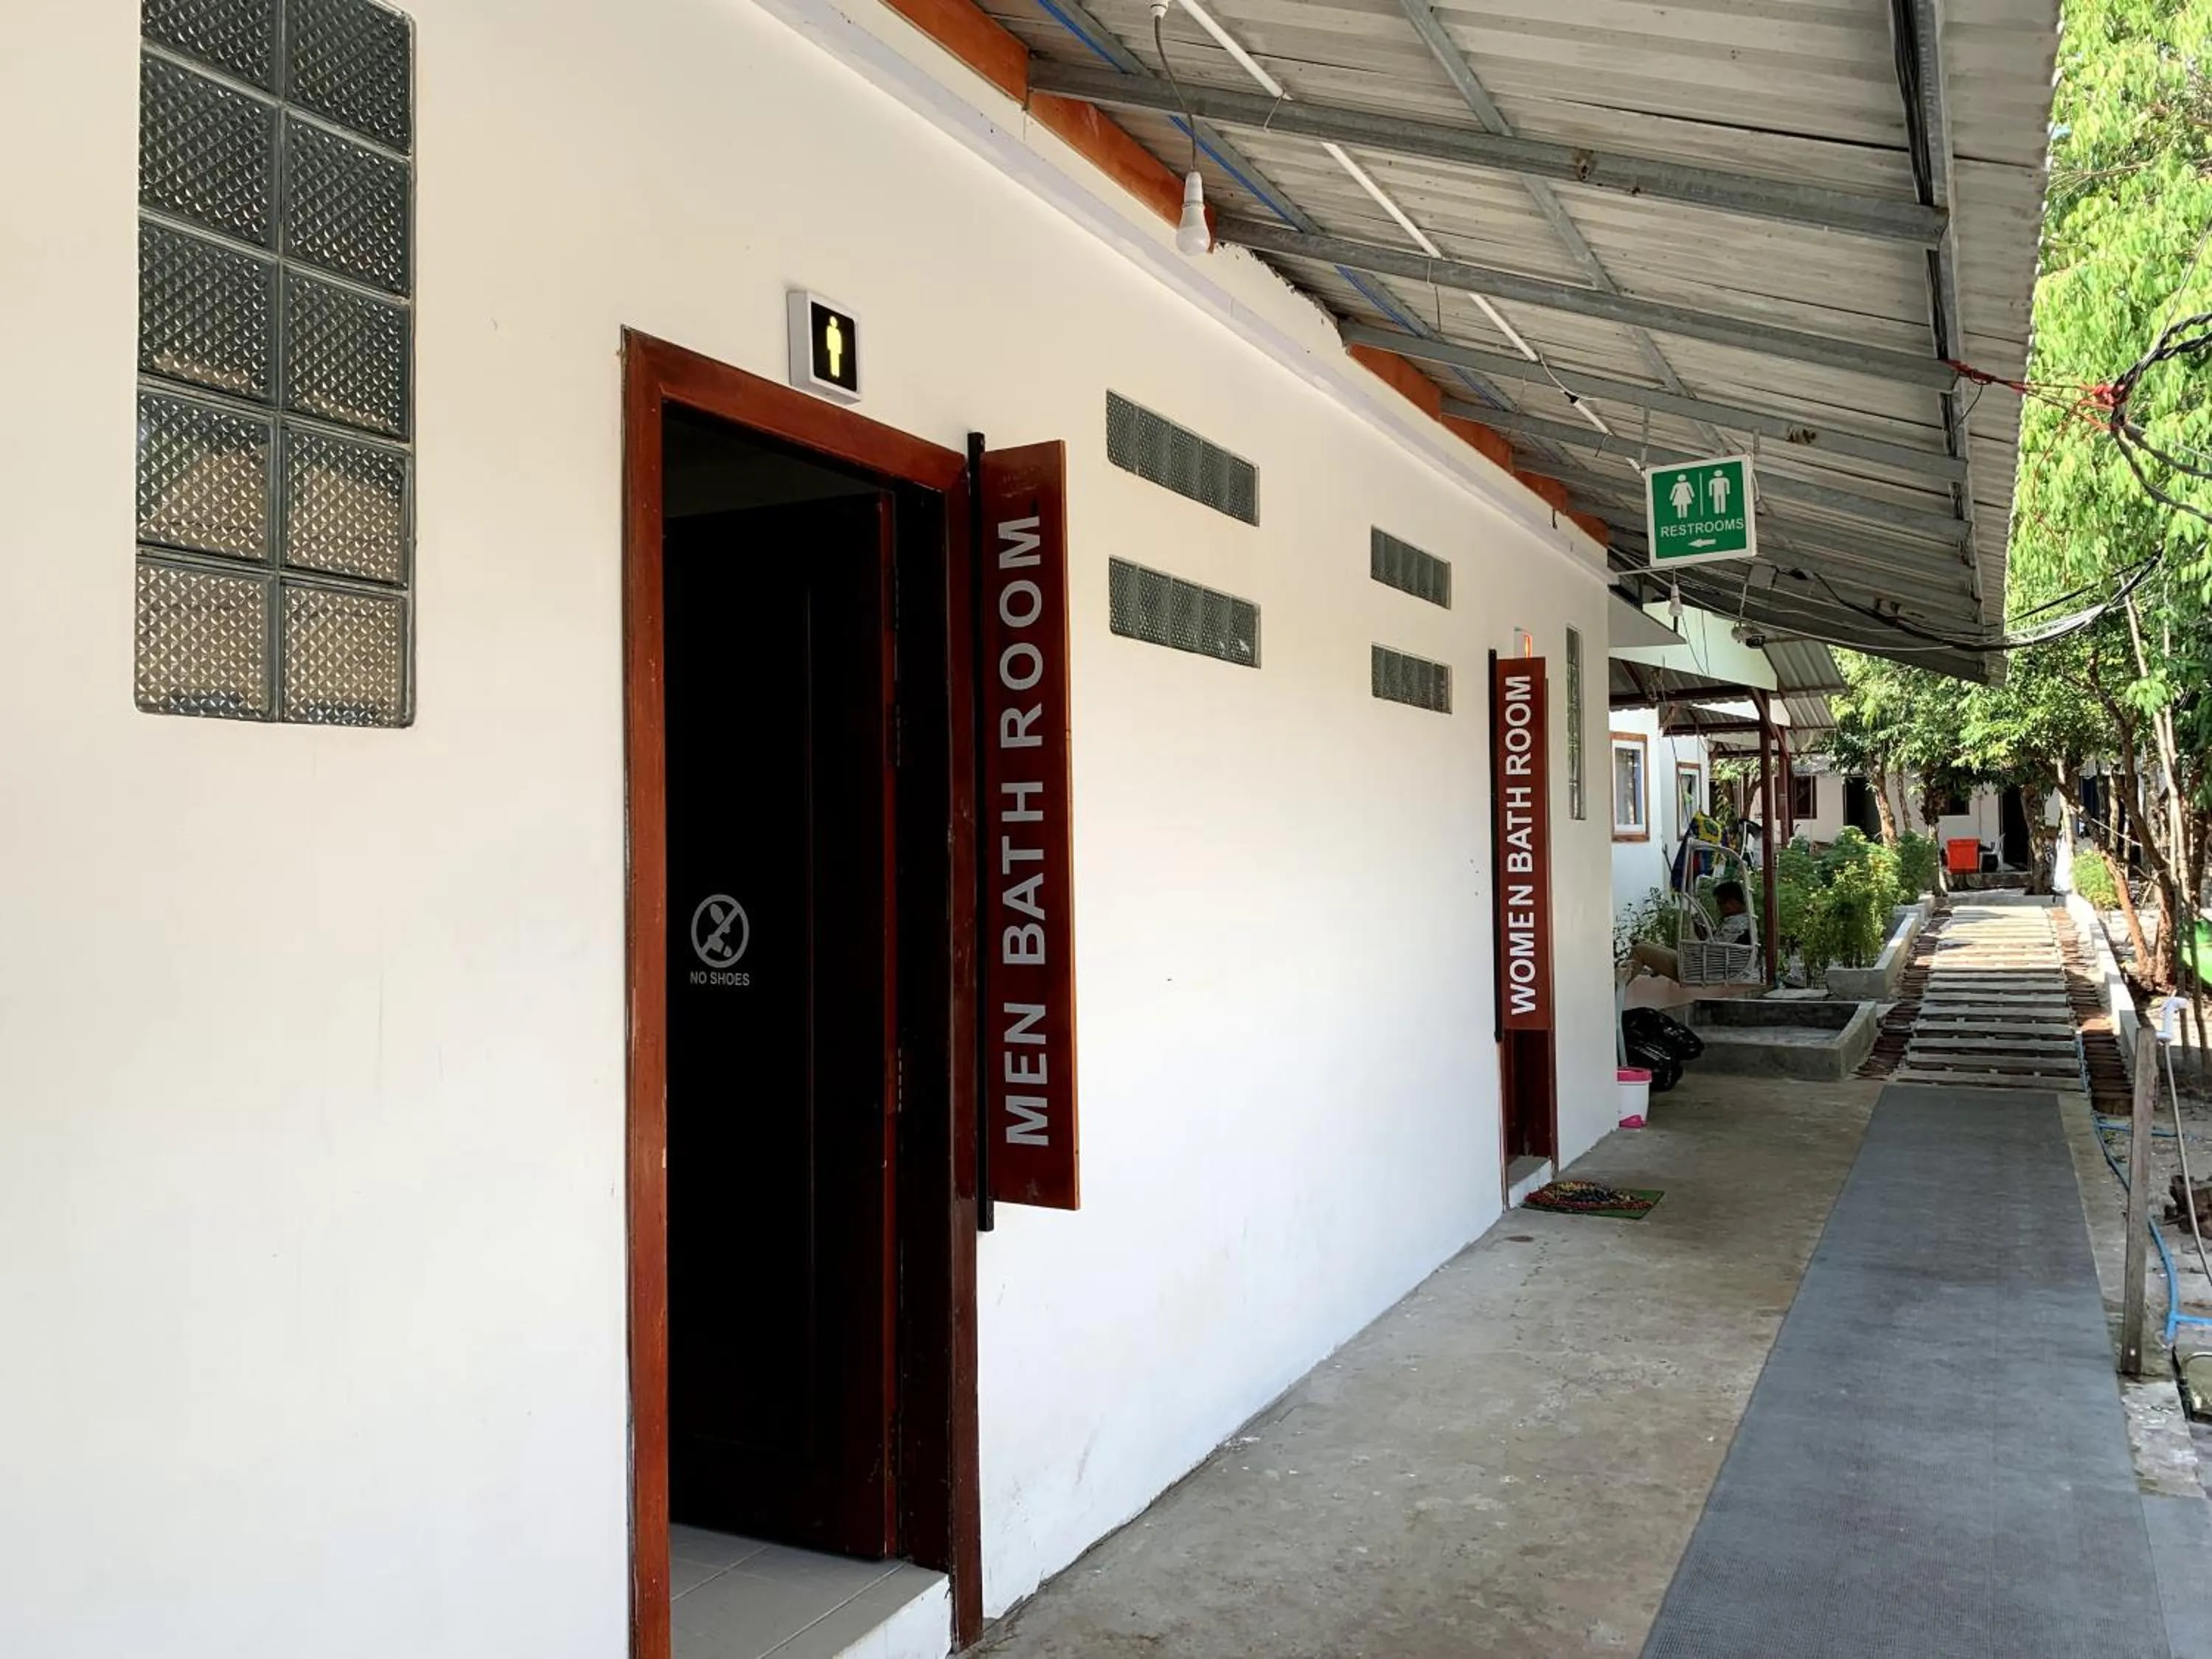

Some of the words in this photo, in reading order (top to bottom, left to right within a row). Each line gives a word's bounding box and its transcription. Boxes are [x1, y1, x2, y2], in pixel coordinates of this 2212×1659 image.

[1660, 518, 1745, 538] RESTROOMS
[998, 515, 1043, 748] ROOM
[1505, 676, 1531, 775] ROOM
[1001, 782, 1046, 965] BATH
[1506, 787, 1533, 872] BATH
[689, 971, 707, 984] NO
[709, 971, 750, 987] SHOES
[1508, 885, 1536, 1015] WOMEN
[1004, 1002, 1049, 1147] MEN
